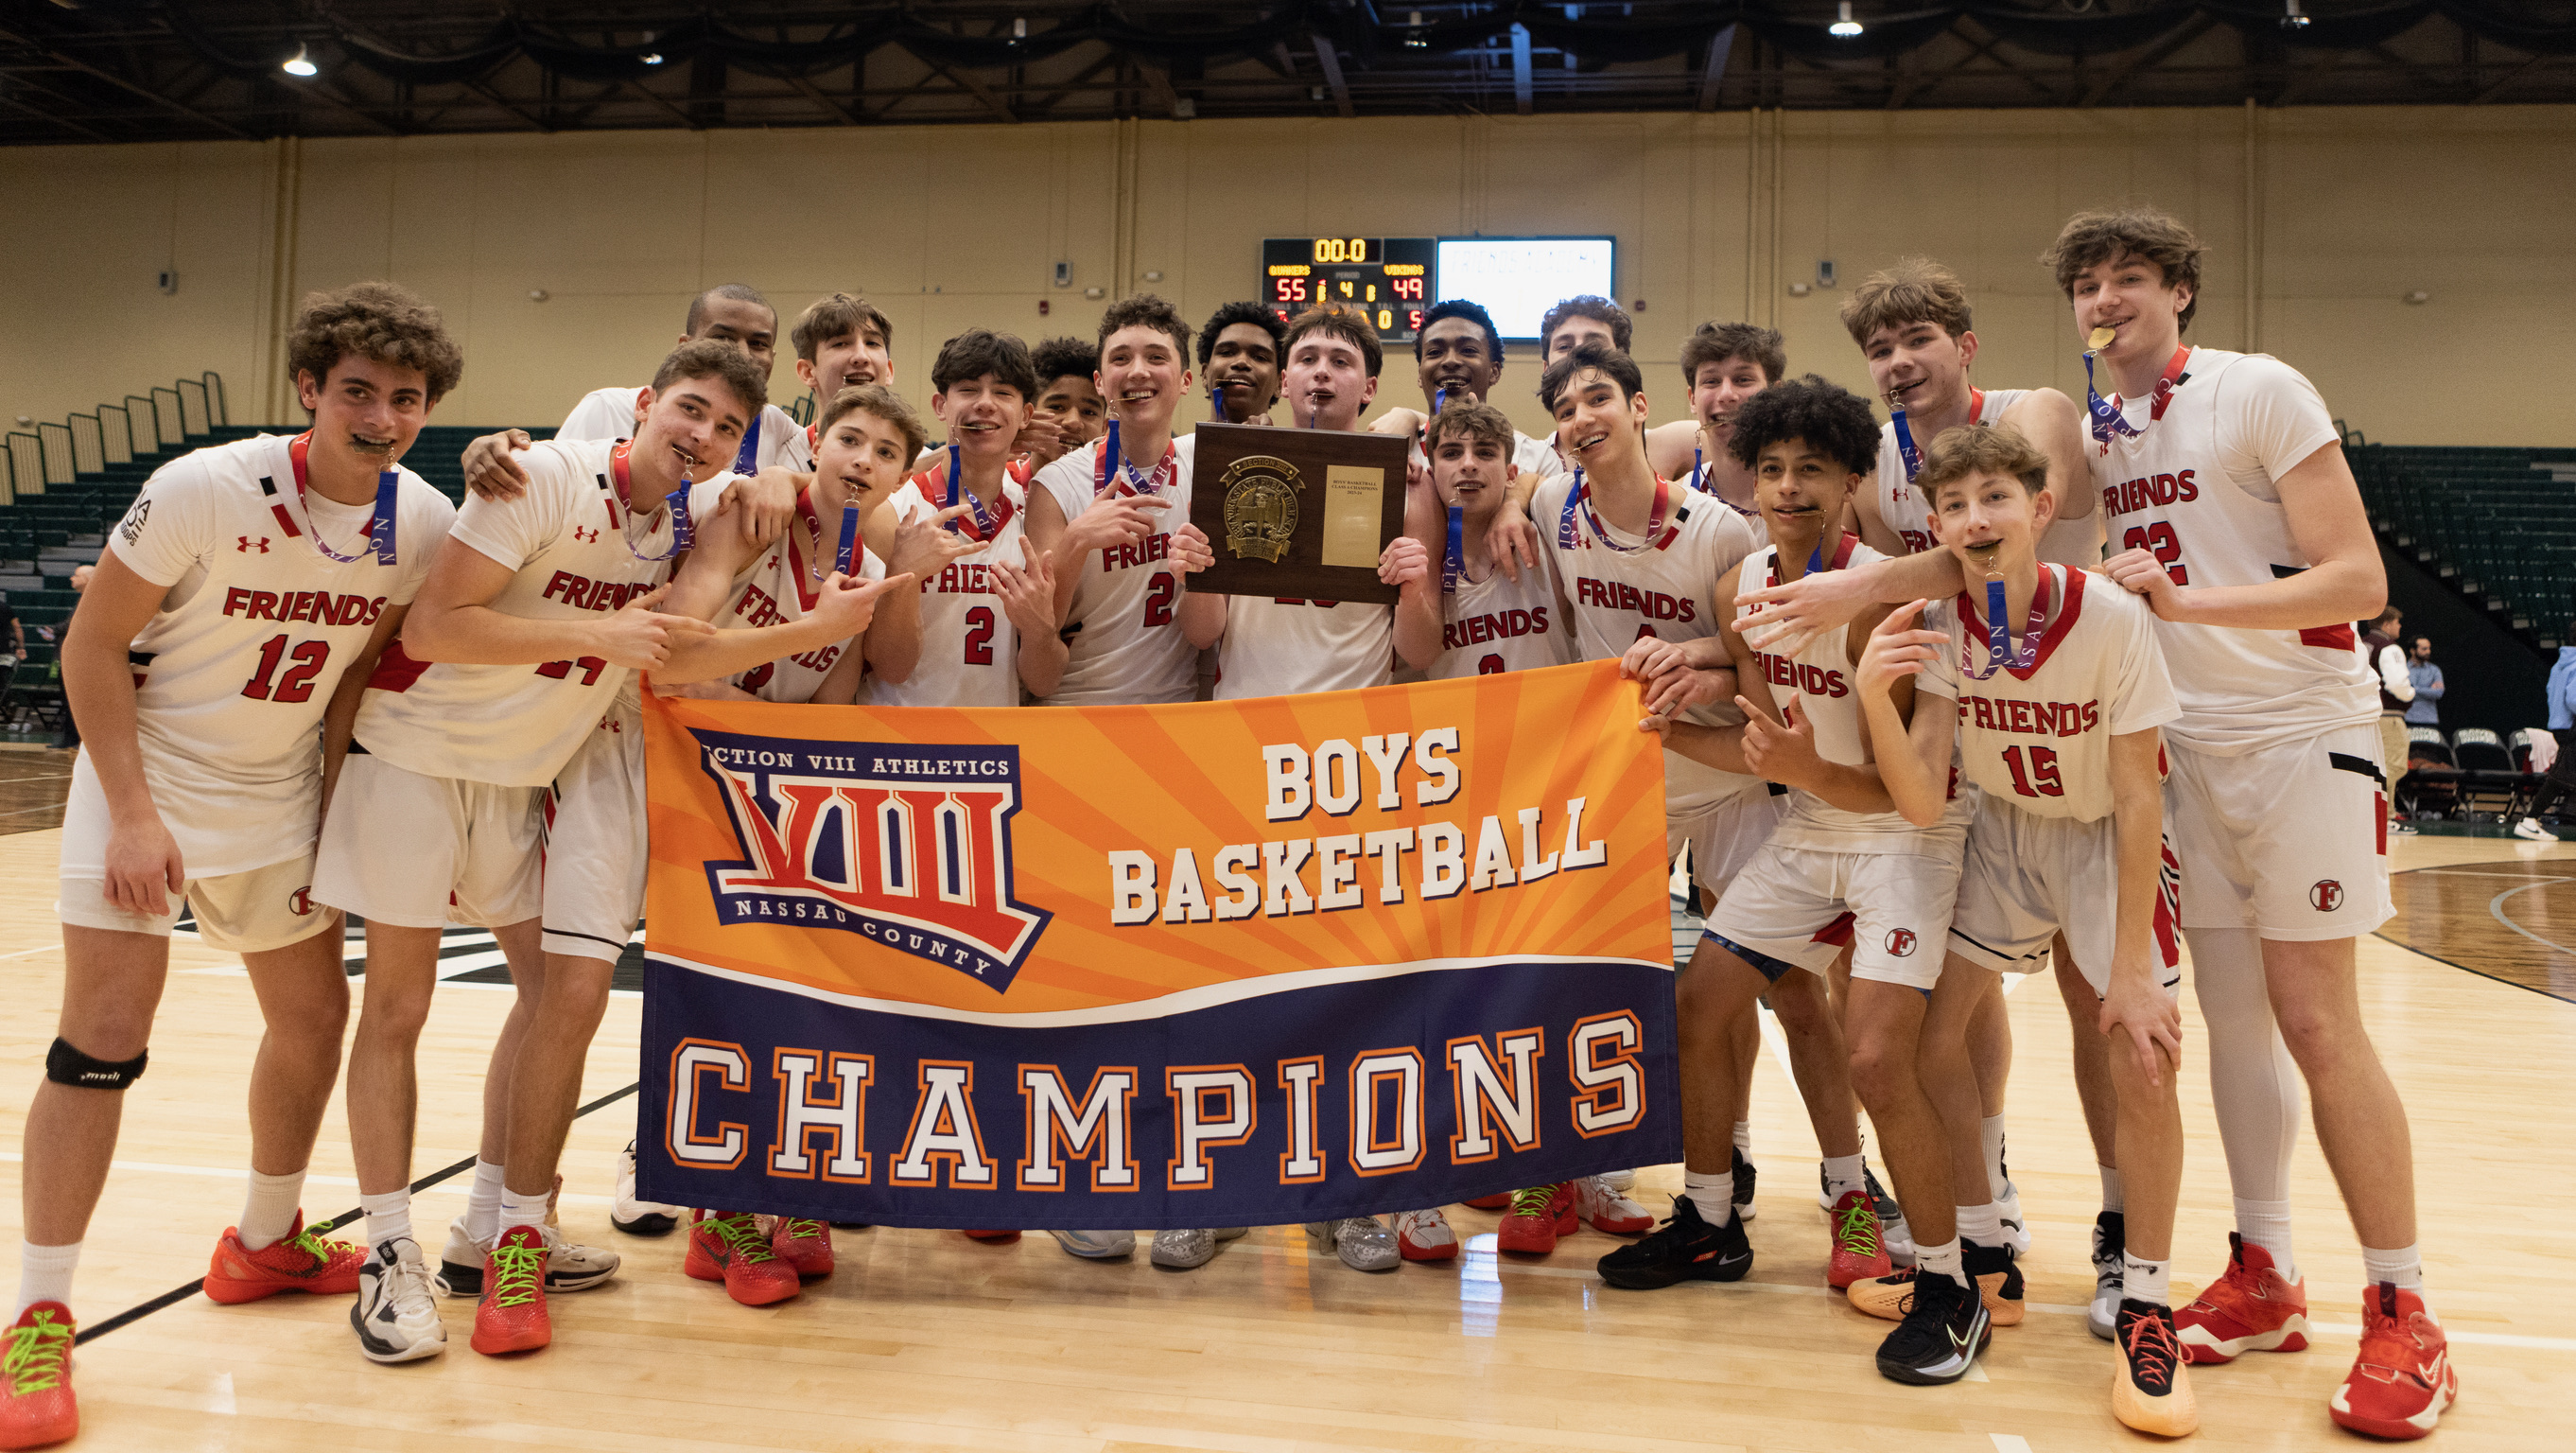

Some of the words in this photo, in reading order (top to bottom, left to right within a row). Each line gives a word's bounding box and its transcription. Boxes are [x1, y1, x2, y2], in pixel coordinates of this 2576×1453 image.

[1268, 265, 1311, 276] QUAKERS
[1315, 238, 1366, 262] 00.0
[1384, 264, 1424, 275] VIKINGS
[1277, 278, 1306, 301] 55
[1339, 281, 1353, 298] 4
[1393, 278, 1423, 299] 49
[1378, 309, 1392, 329] 0
[1409, 309, 1422, 329] 5
[1243, 459, 1276, 467] SECTION
[1233, 478, 1259, 499] STATE
[2102, 469, 2199, 519] FRIENDS
[223, 586, 388, 626] FRIENDS
[1143, 572, 1175, 627] 2
[1577, 576, 1697, 623] FRIENDS
[965, 605, 995, 666] 2
[1442, 606, 1549, 651] RIENDS
[241, 634, 331, 703] 12
[1958, 695, 2098, 738] FRIENDS
[703, 744, 794, 768] CTION
[807, 755, 857, 772] VIII
[872, 759, 1010, 776] ATHLETICS
[1262, 726, 1461, 823] BOYS
[2001, 745, 2064, 797] 15
[716, 771, 1041, 967] VIII
[1108, 796, 1607, 926] BASKETBALL
[736, 900, 847, 933] NASSAU
[862, 921, 992, 976] COUNTY
[667, 1009, 1646, 1194] CHAMPIONS
